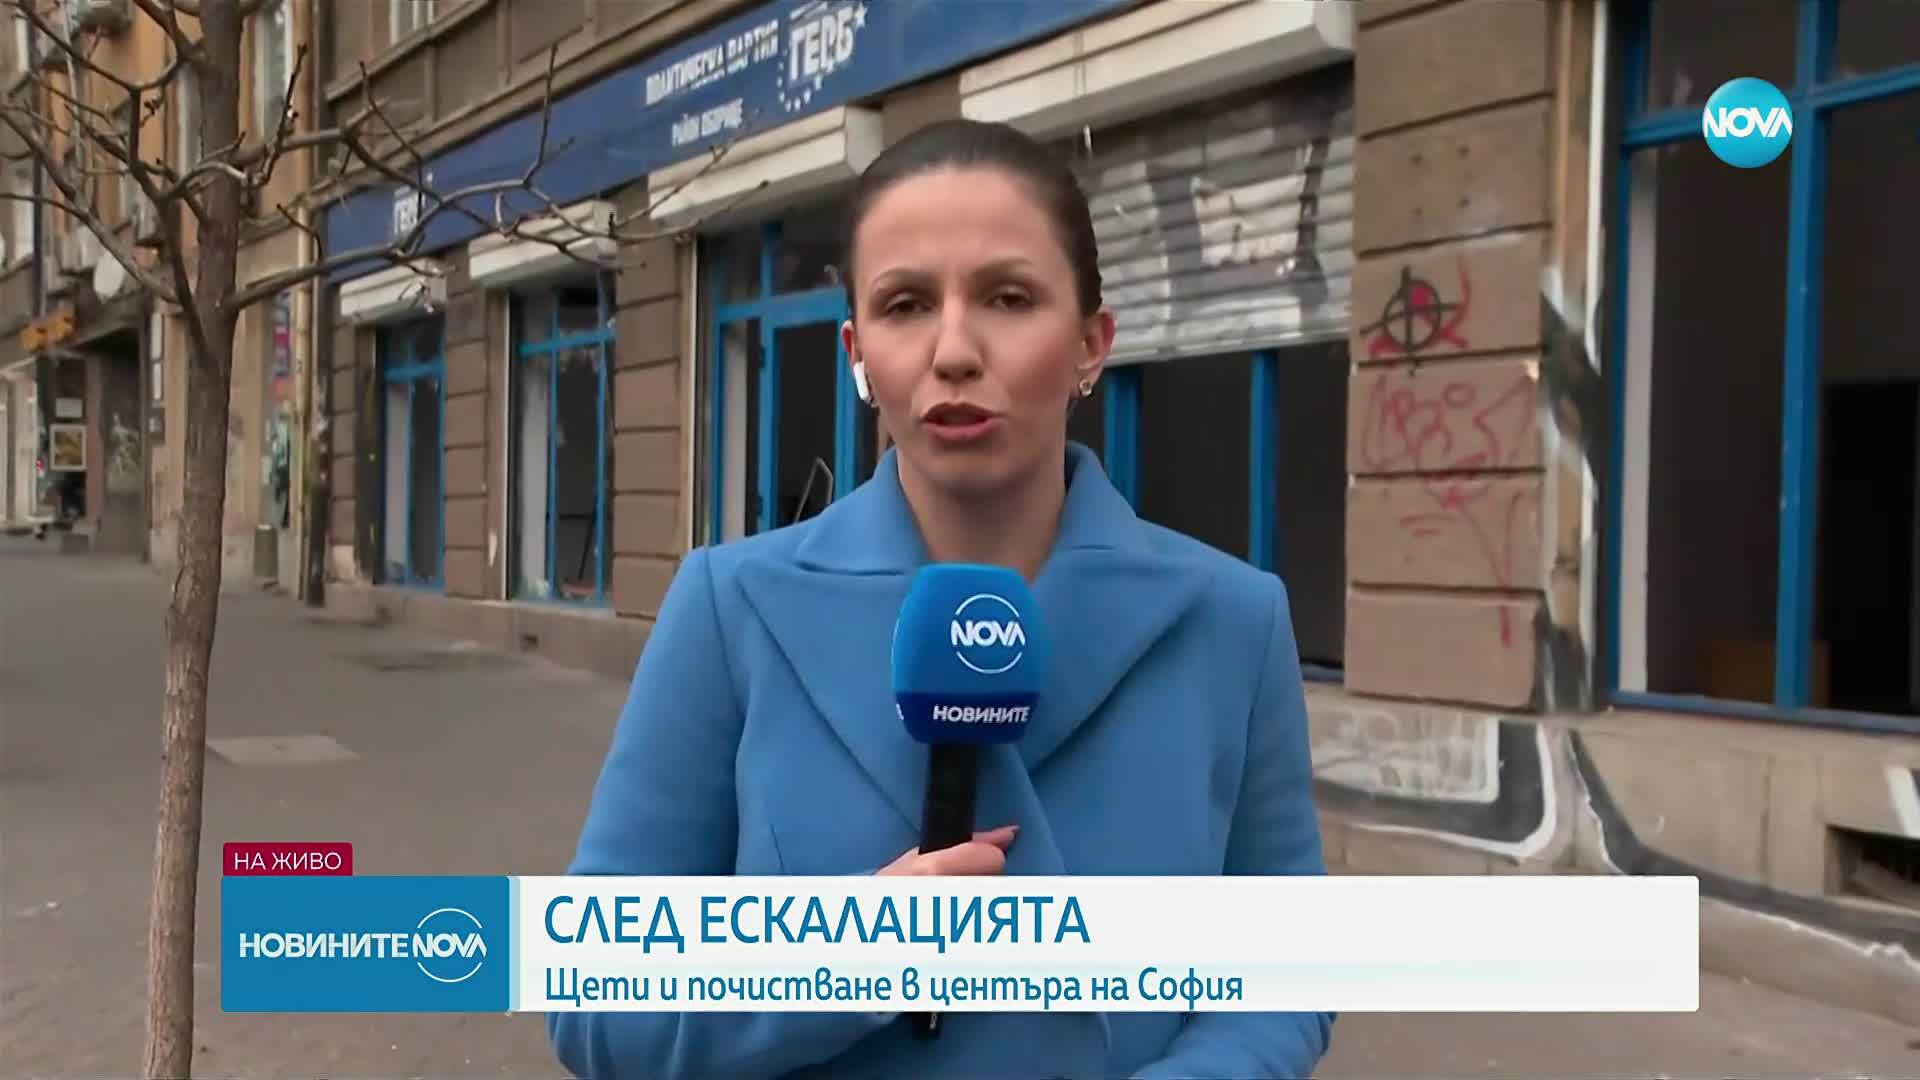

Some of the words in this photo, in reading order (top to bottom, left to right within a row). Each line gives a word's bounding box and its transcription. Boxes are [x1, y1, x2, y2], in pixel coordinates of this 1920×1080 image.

[789, 7, 855, 82] ГЕРБ
[951, 619, 1026, 648] NOVA
[932, 704, 1031, 724] НОВИНИТЕ
